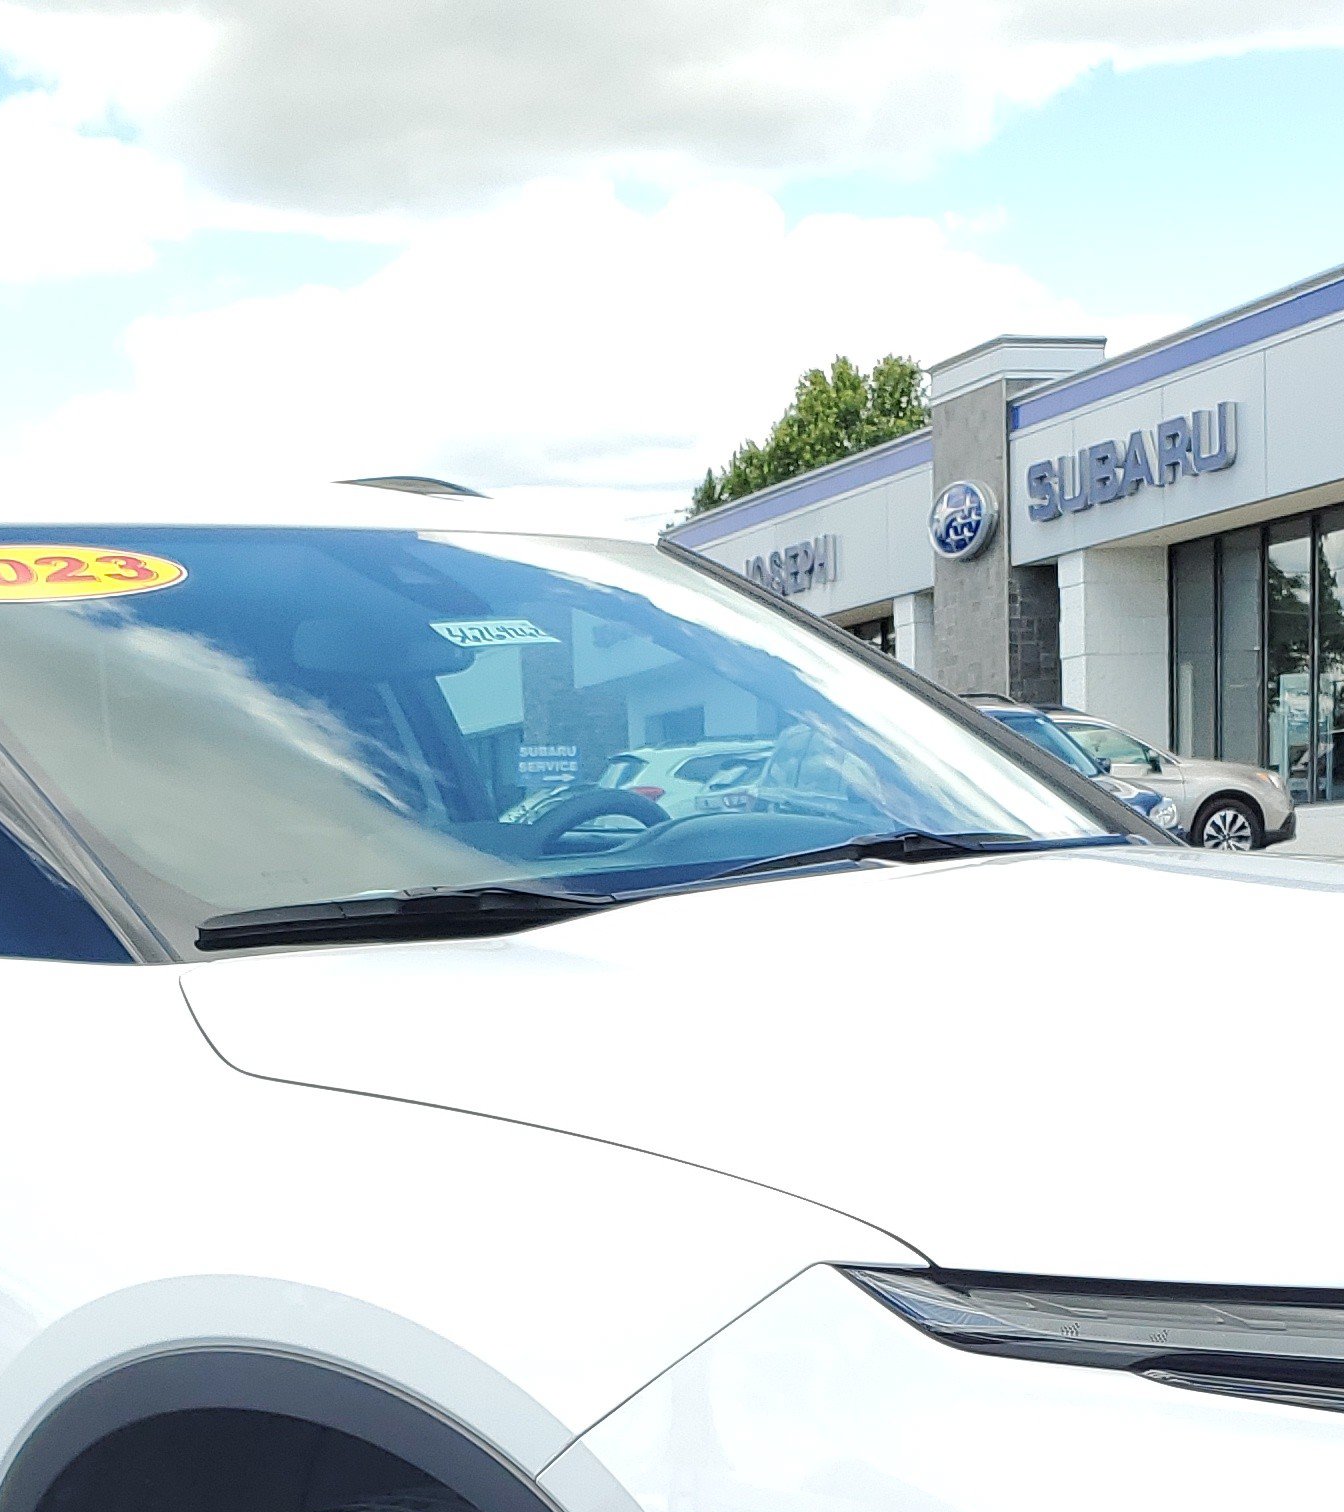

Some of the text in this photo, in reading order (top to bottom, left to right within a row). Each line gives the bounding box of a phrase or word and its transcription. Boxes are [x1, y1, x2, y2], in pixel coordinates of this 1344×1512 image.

[1027, 401, 1238, 522] SUBARU
[519, 745, 577, 757] SUBARU
[518, 761, 578, 773] SERVICE
